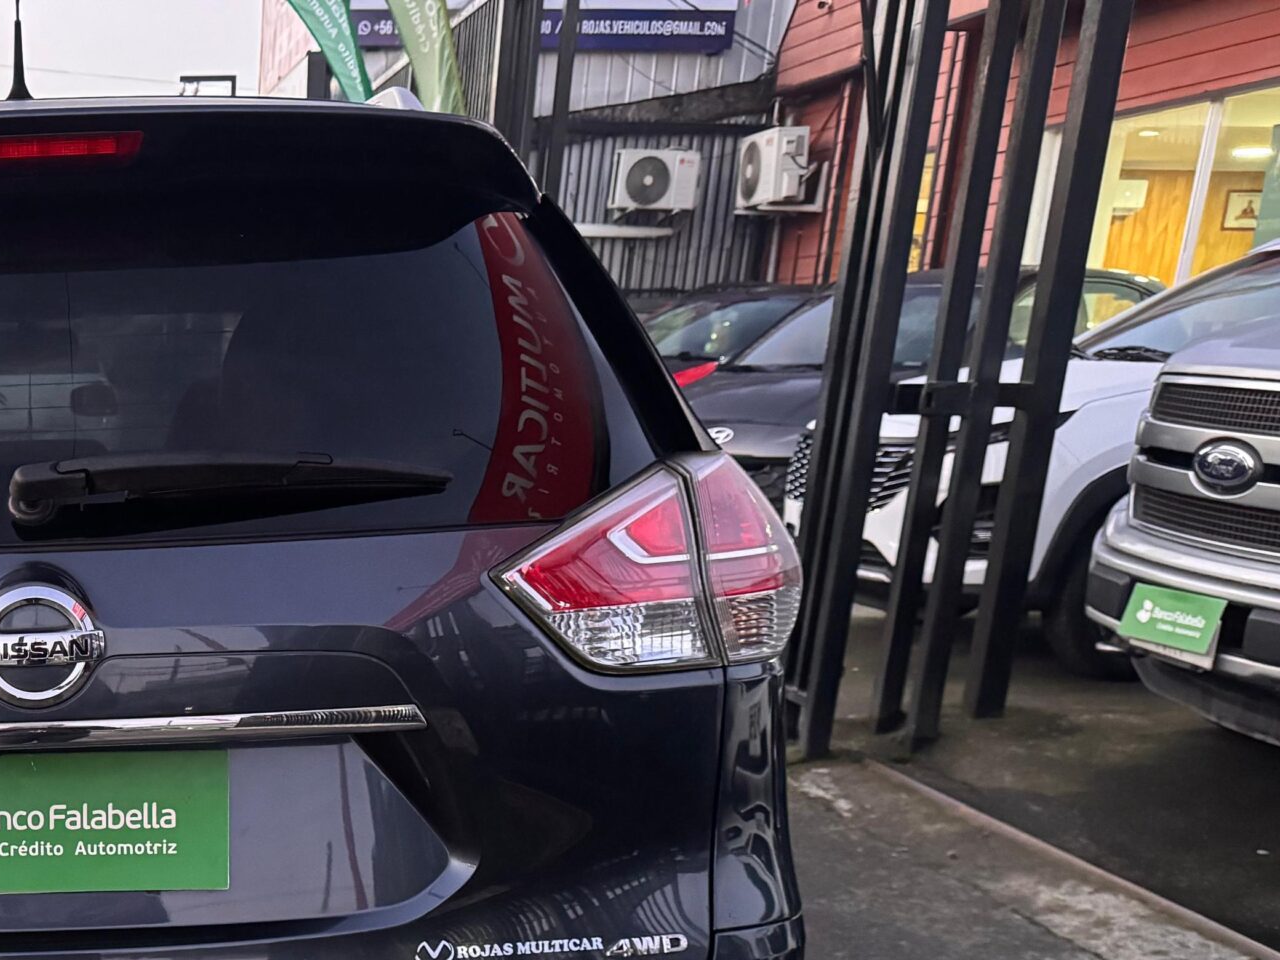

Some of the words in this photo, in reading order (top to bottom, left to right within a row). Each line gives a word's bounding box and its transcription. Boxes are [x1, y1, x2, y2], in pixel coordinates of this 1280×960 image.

[75, 839, 178, 856] Automotriz
[456, 942, 514, 960] ROJAS
[516, 936, 604, 955] MULTICAR
[606, 933, 688, 958] 4WD
